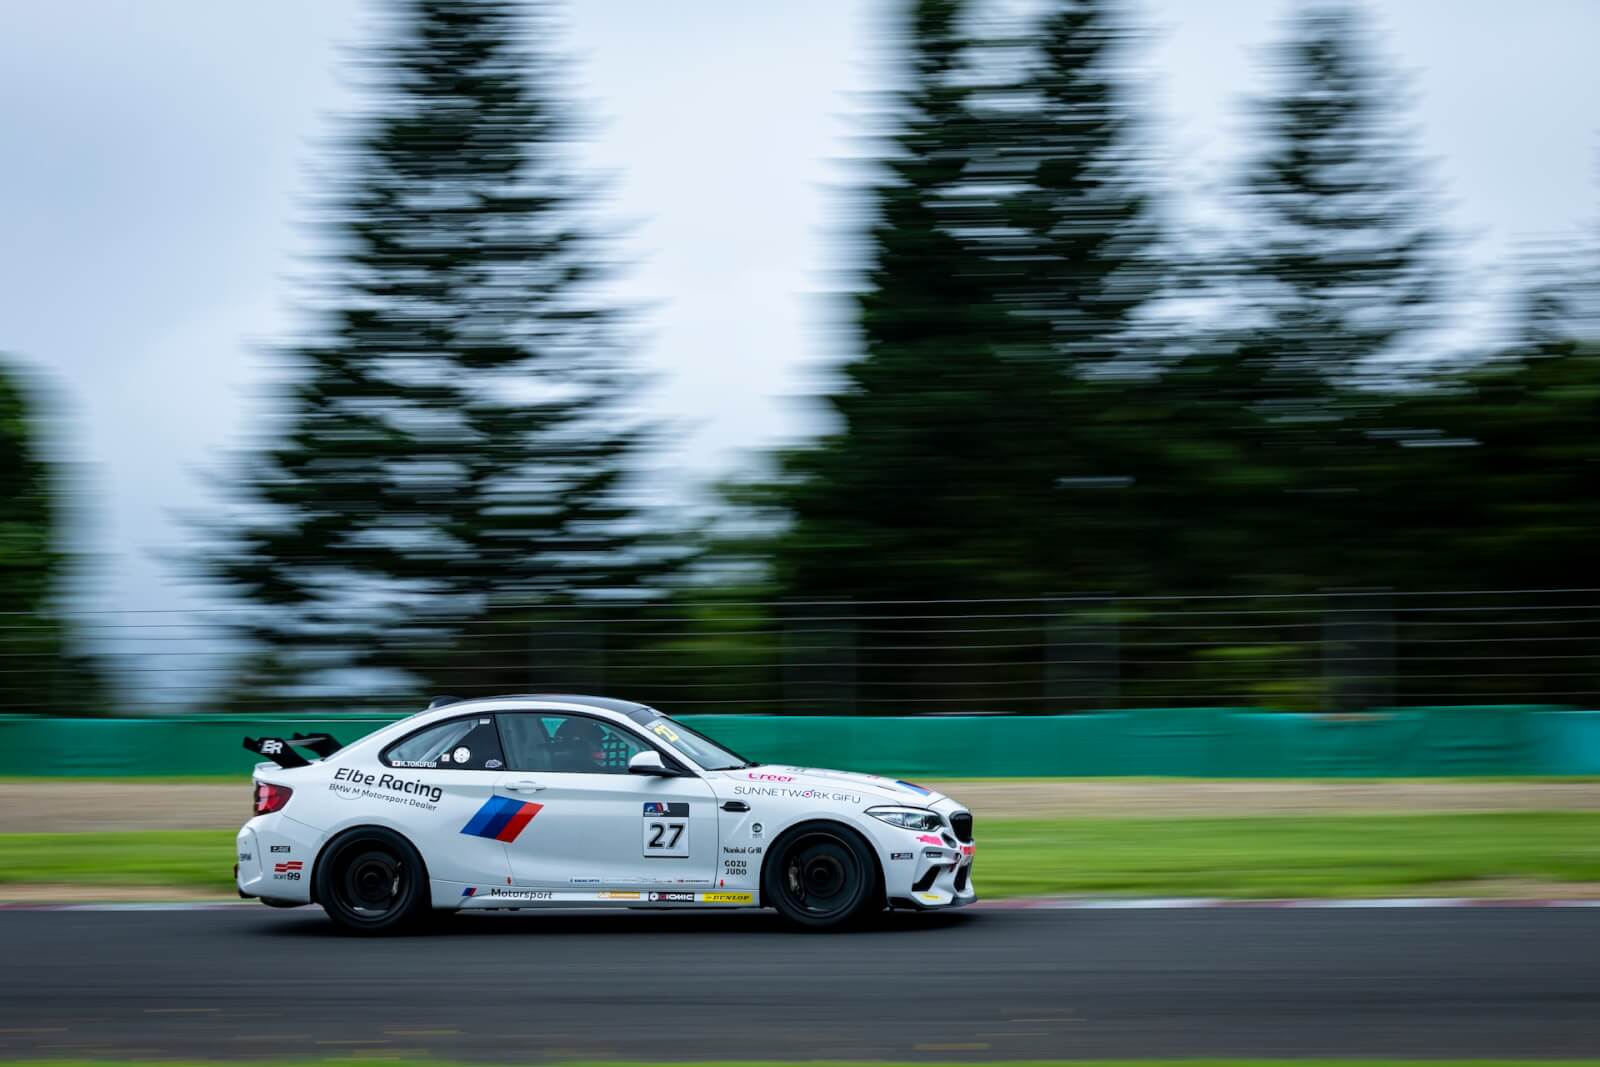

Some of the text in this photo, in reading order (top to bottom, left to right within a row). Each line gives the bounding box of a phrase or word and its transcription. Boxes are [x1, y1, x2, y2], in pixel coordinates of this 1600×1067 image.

[261, 740, 283, 754] ER
[334, 767, 443, 802] Elbe Racing
[329, 783, 351, 793] BMW
[362, 788, 408, 804] Motorsport
[409, 798, 438, 811] Dealer
[832, 793, 861, 804] GIFU
[648, 823, 685, 849] 27
[490, 888, 552, 902] Motorsport
